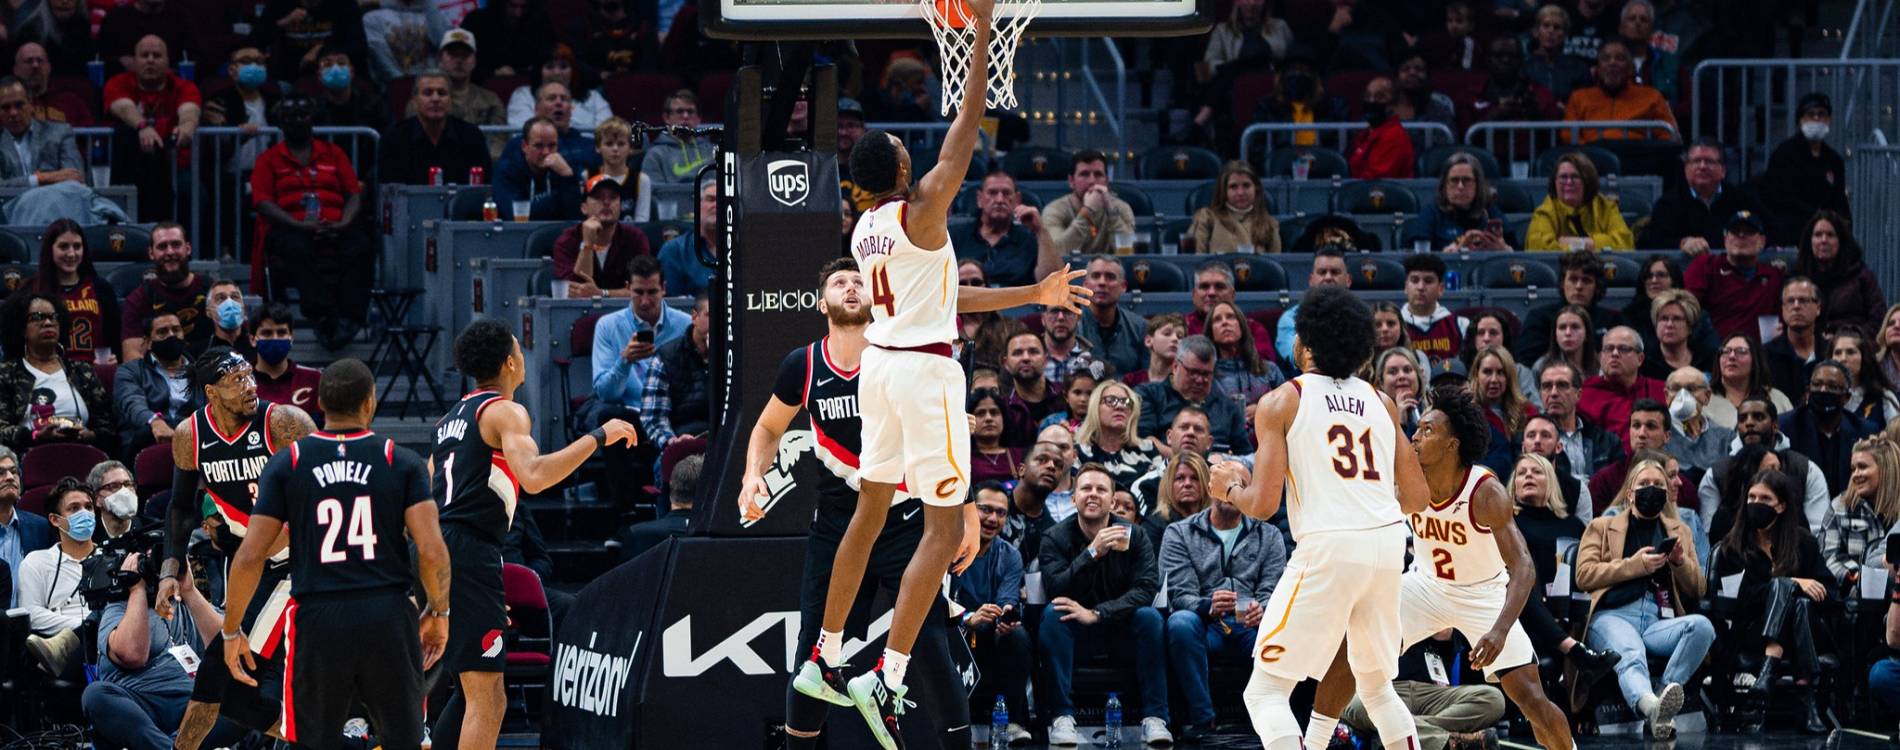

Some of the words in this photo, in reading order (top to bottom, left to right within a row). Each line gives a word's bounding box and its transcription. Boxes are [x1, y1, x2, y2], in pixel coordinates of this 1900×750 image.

[771, 174, 807, 199] ups
[856, 235, 896, 261] MOBLEY
[871, 262, 895, 317] 4
[291, 387, 313, 406] C
[1324, 394, 1365, 418] ALLEN
[437, 418, 468, 445] SIMONS
[1327, 424, 1381, 482] 31
[312, 460, 373, 488] POWELL
[443, 451, 455, 507] 1
[316, 495, 378, 564] 24
[1411, 511, 1468, 547] CAVS
[1432, 547, 1456, 582] 2
[552, 631, 627, 718] verizon
